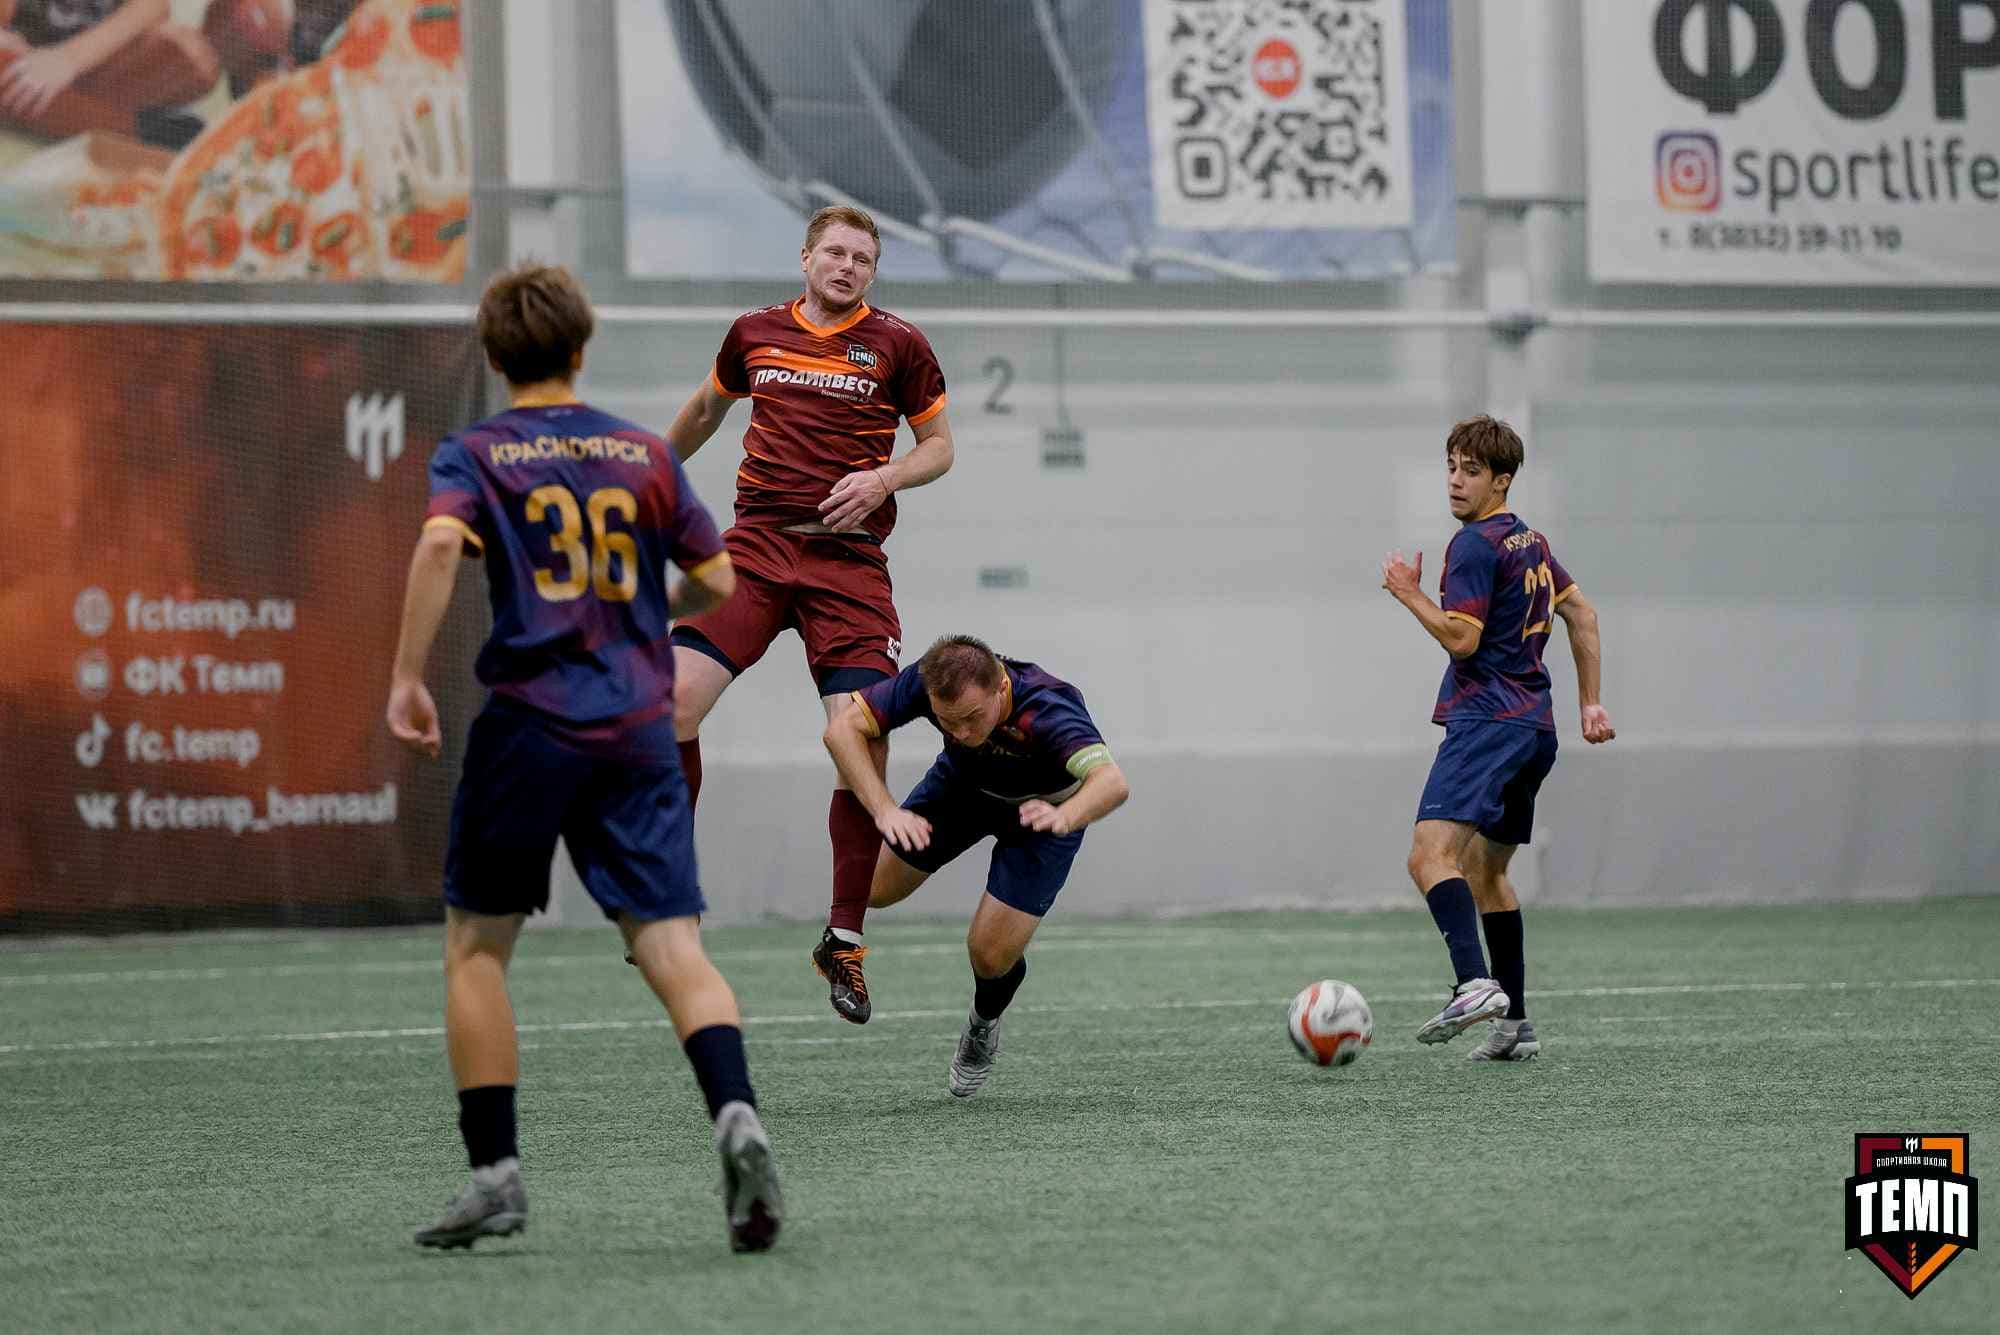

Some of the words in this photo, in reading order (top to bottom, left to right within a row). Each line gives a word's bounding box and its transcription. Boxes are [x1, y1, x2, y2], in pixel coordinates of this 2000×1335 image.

[1732, 138, 2000, 212] sportlife
[755, 369, 878, 397] ПРОДИНВЕСТ
[980, 357, 1015, 414] 2
[489, 435, 650, 466] КРАСНОЯРСК
[525, 483, 638, 603] 36
[126, 592, 295, 639] fctemp.ru
[124, 656, 186, 695] ФК
[191, 655, 285, 693] Темп
[126, 721, 260, 768] fc.temp
[128, 782, 398, 833] fctemp_barnaul
